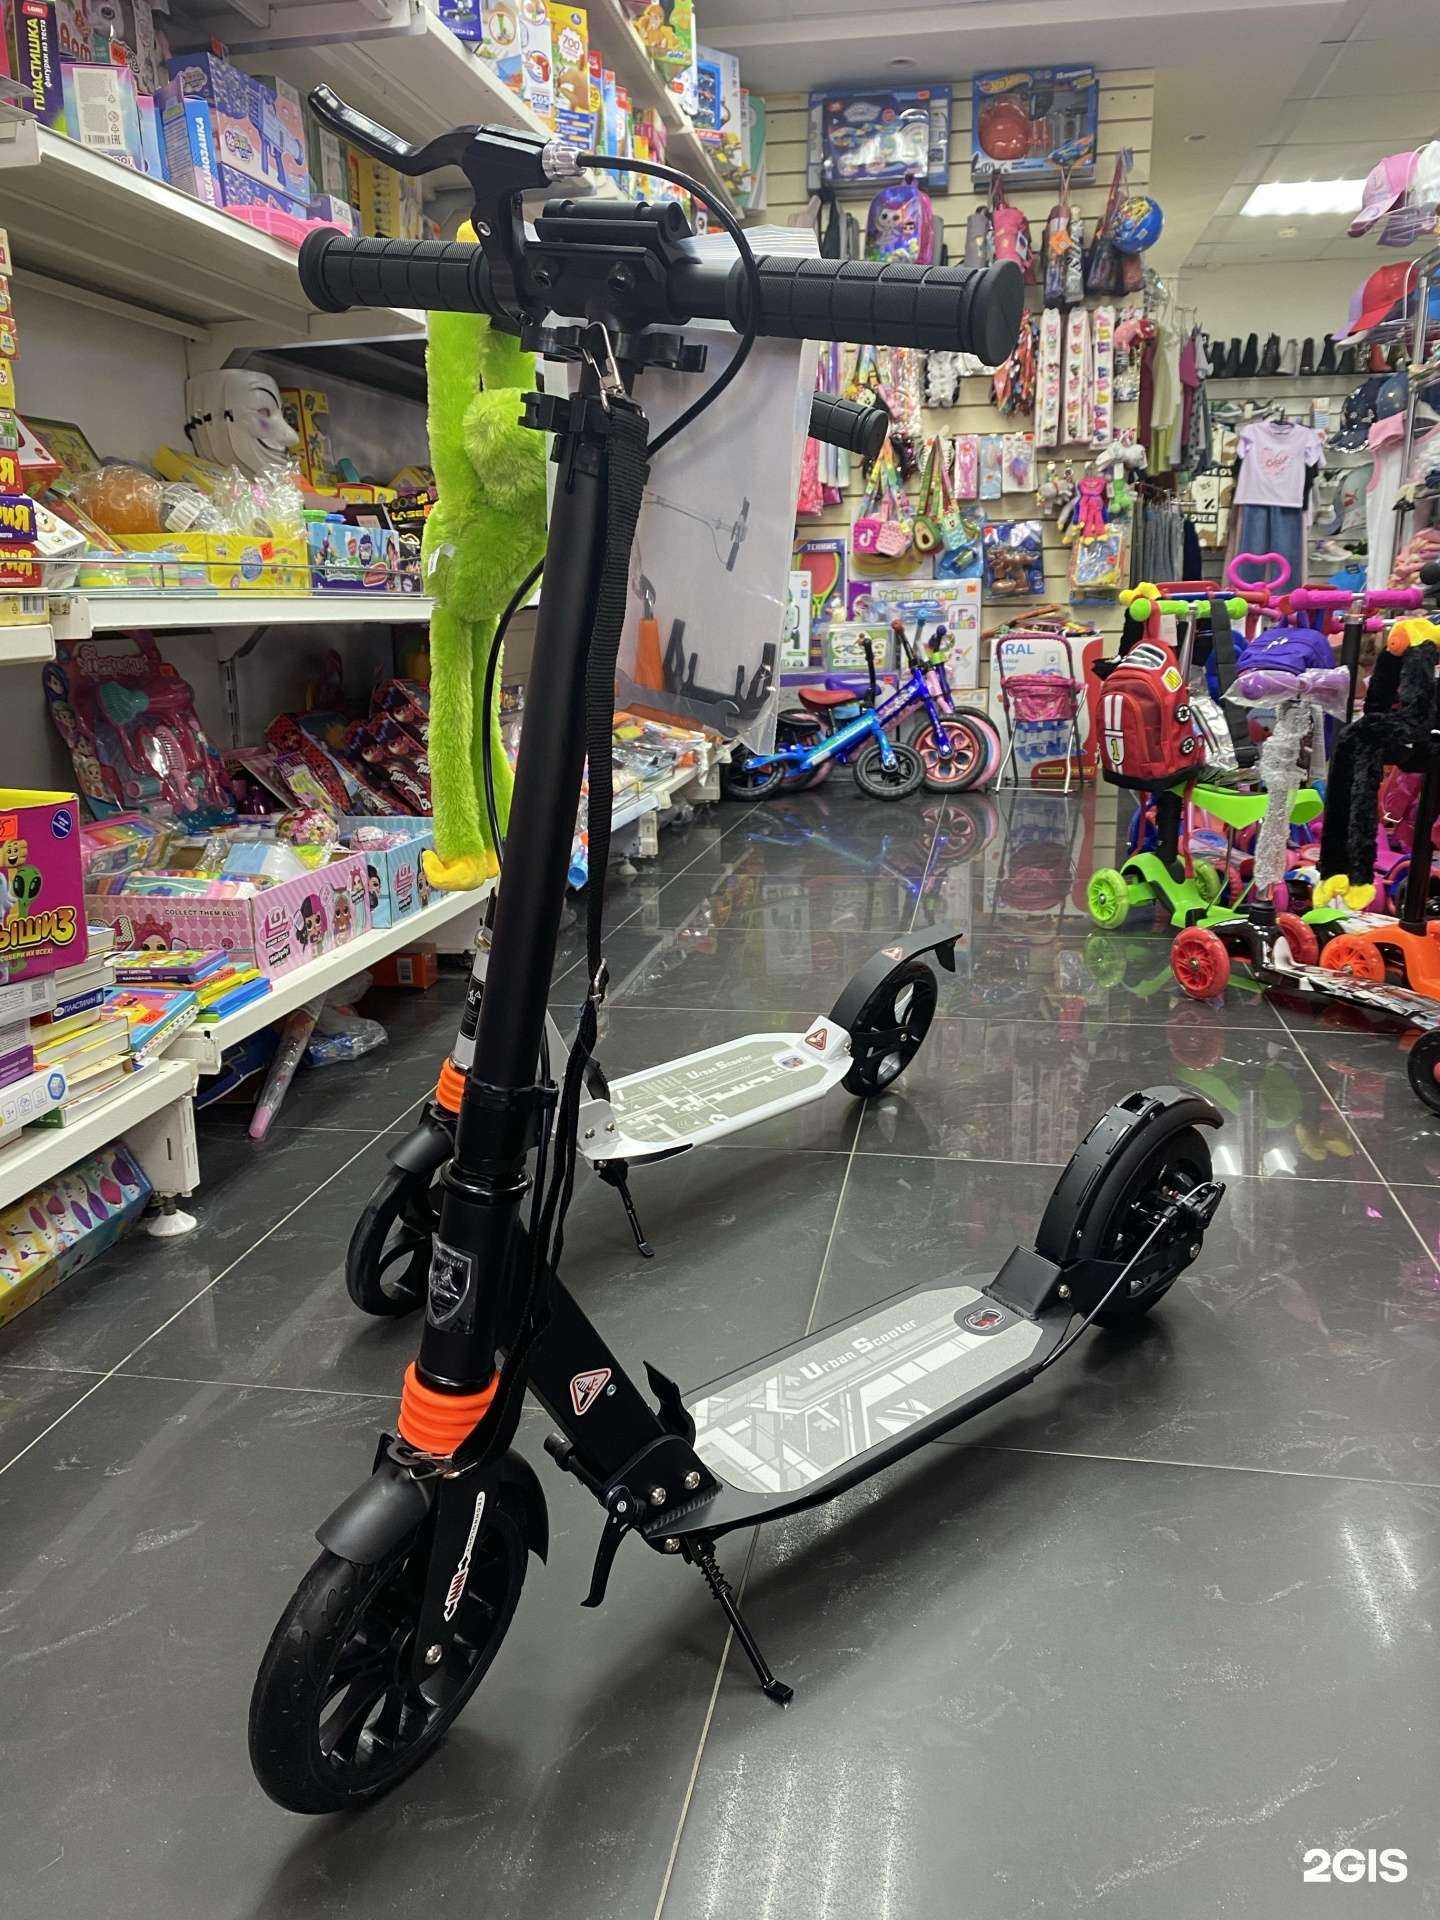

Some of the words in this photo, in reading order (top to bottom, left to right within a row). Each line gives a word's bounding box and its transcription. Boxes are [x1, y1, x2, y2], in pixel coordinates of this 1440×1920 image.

[26, 18, 46, 111] ПЛАСТИШКА
[43, 53, 53, 88] фигурки
[799, 1351, 857, 1380] Urban
[851, 1319, 918, 1354] Scooter
